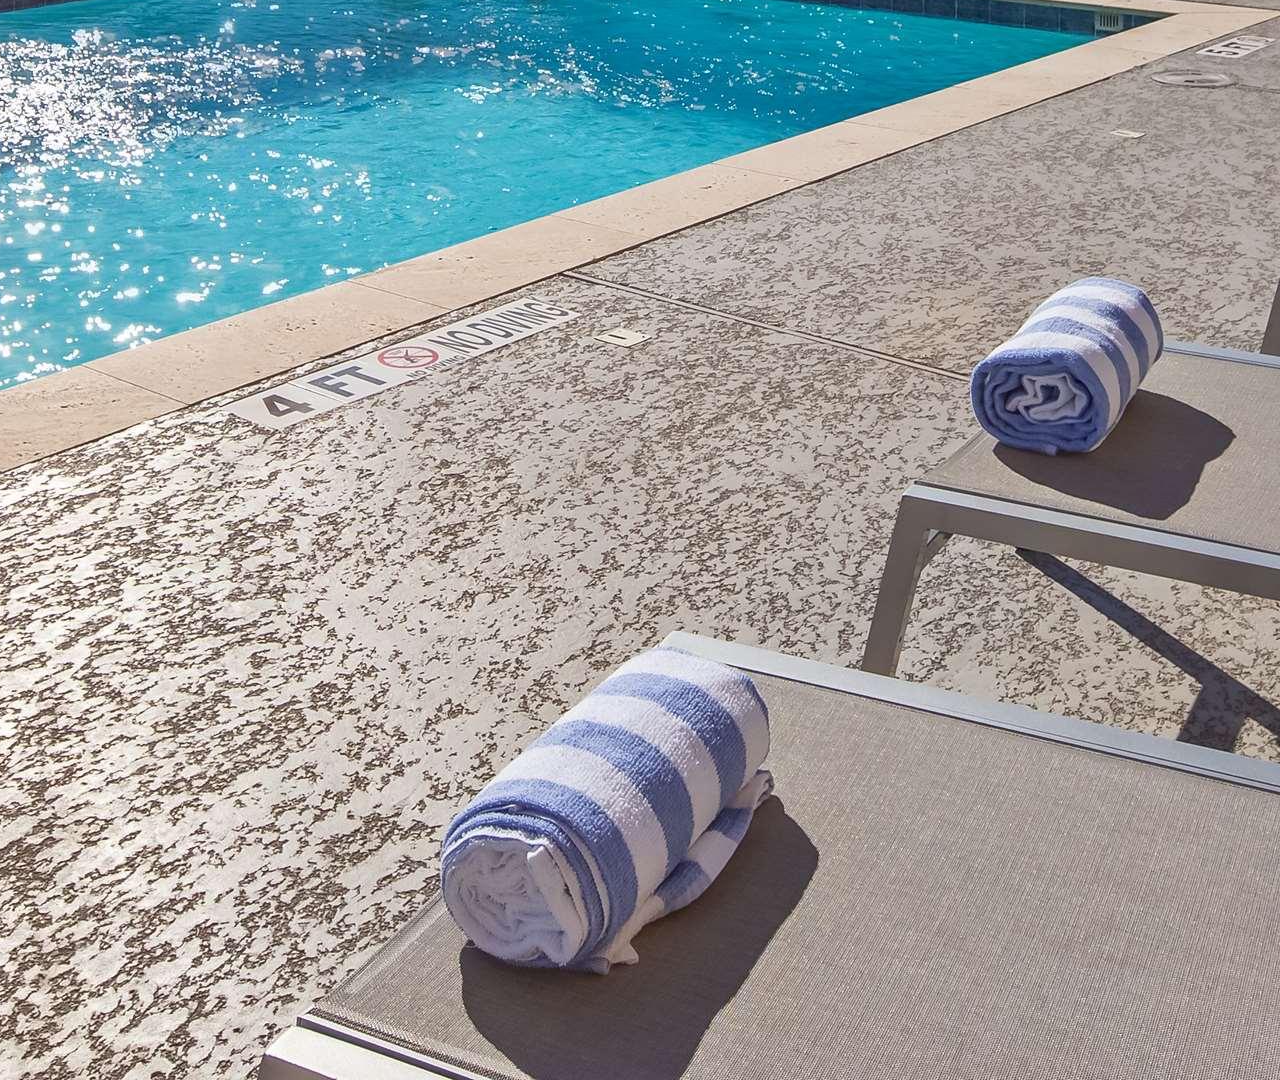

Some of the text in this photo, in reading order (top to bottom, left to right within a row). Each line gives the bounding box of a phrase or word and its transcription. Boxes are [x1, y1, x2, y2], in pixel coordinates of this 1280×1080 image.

[427, 302, 569, 354] NO DIVING
[262, 366, 387, 417] 4 FT
[406, 354, 466, 379] NO DIVING
